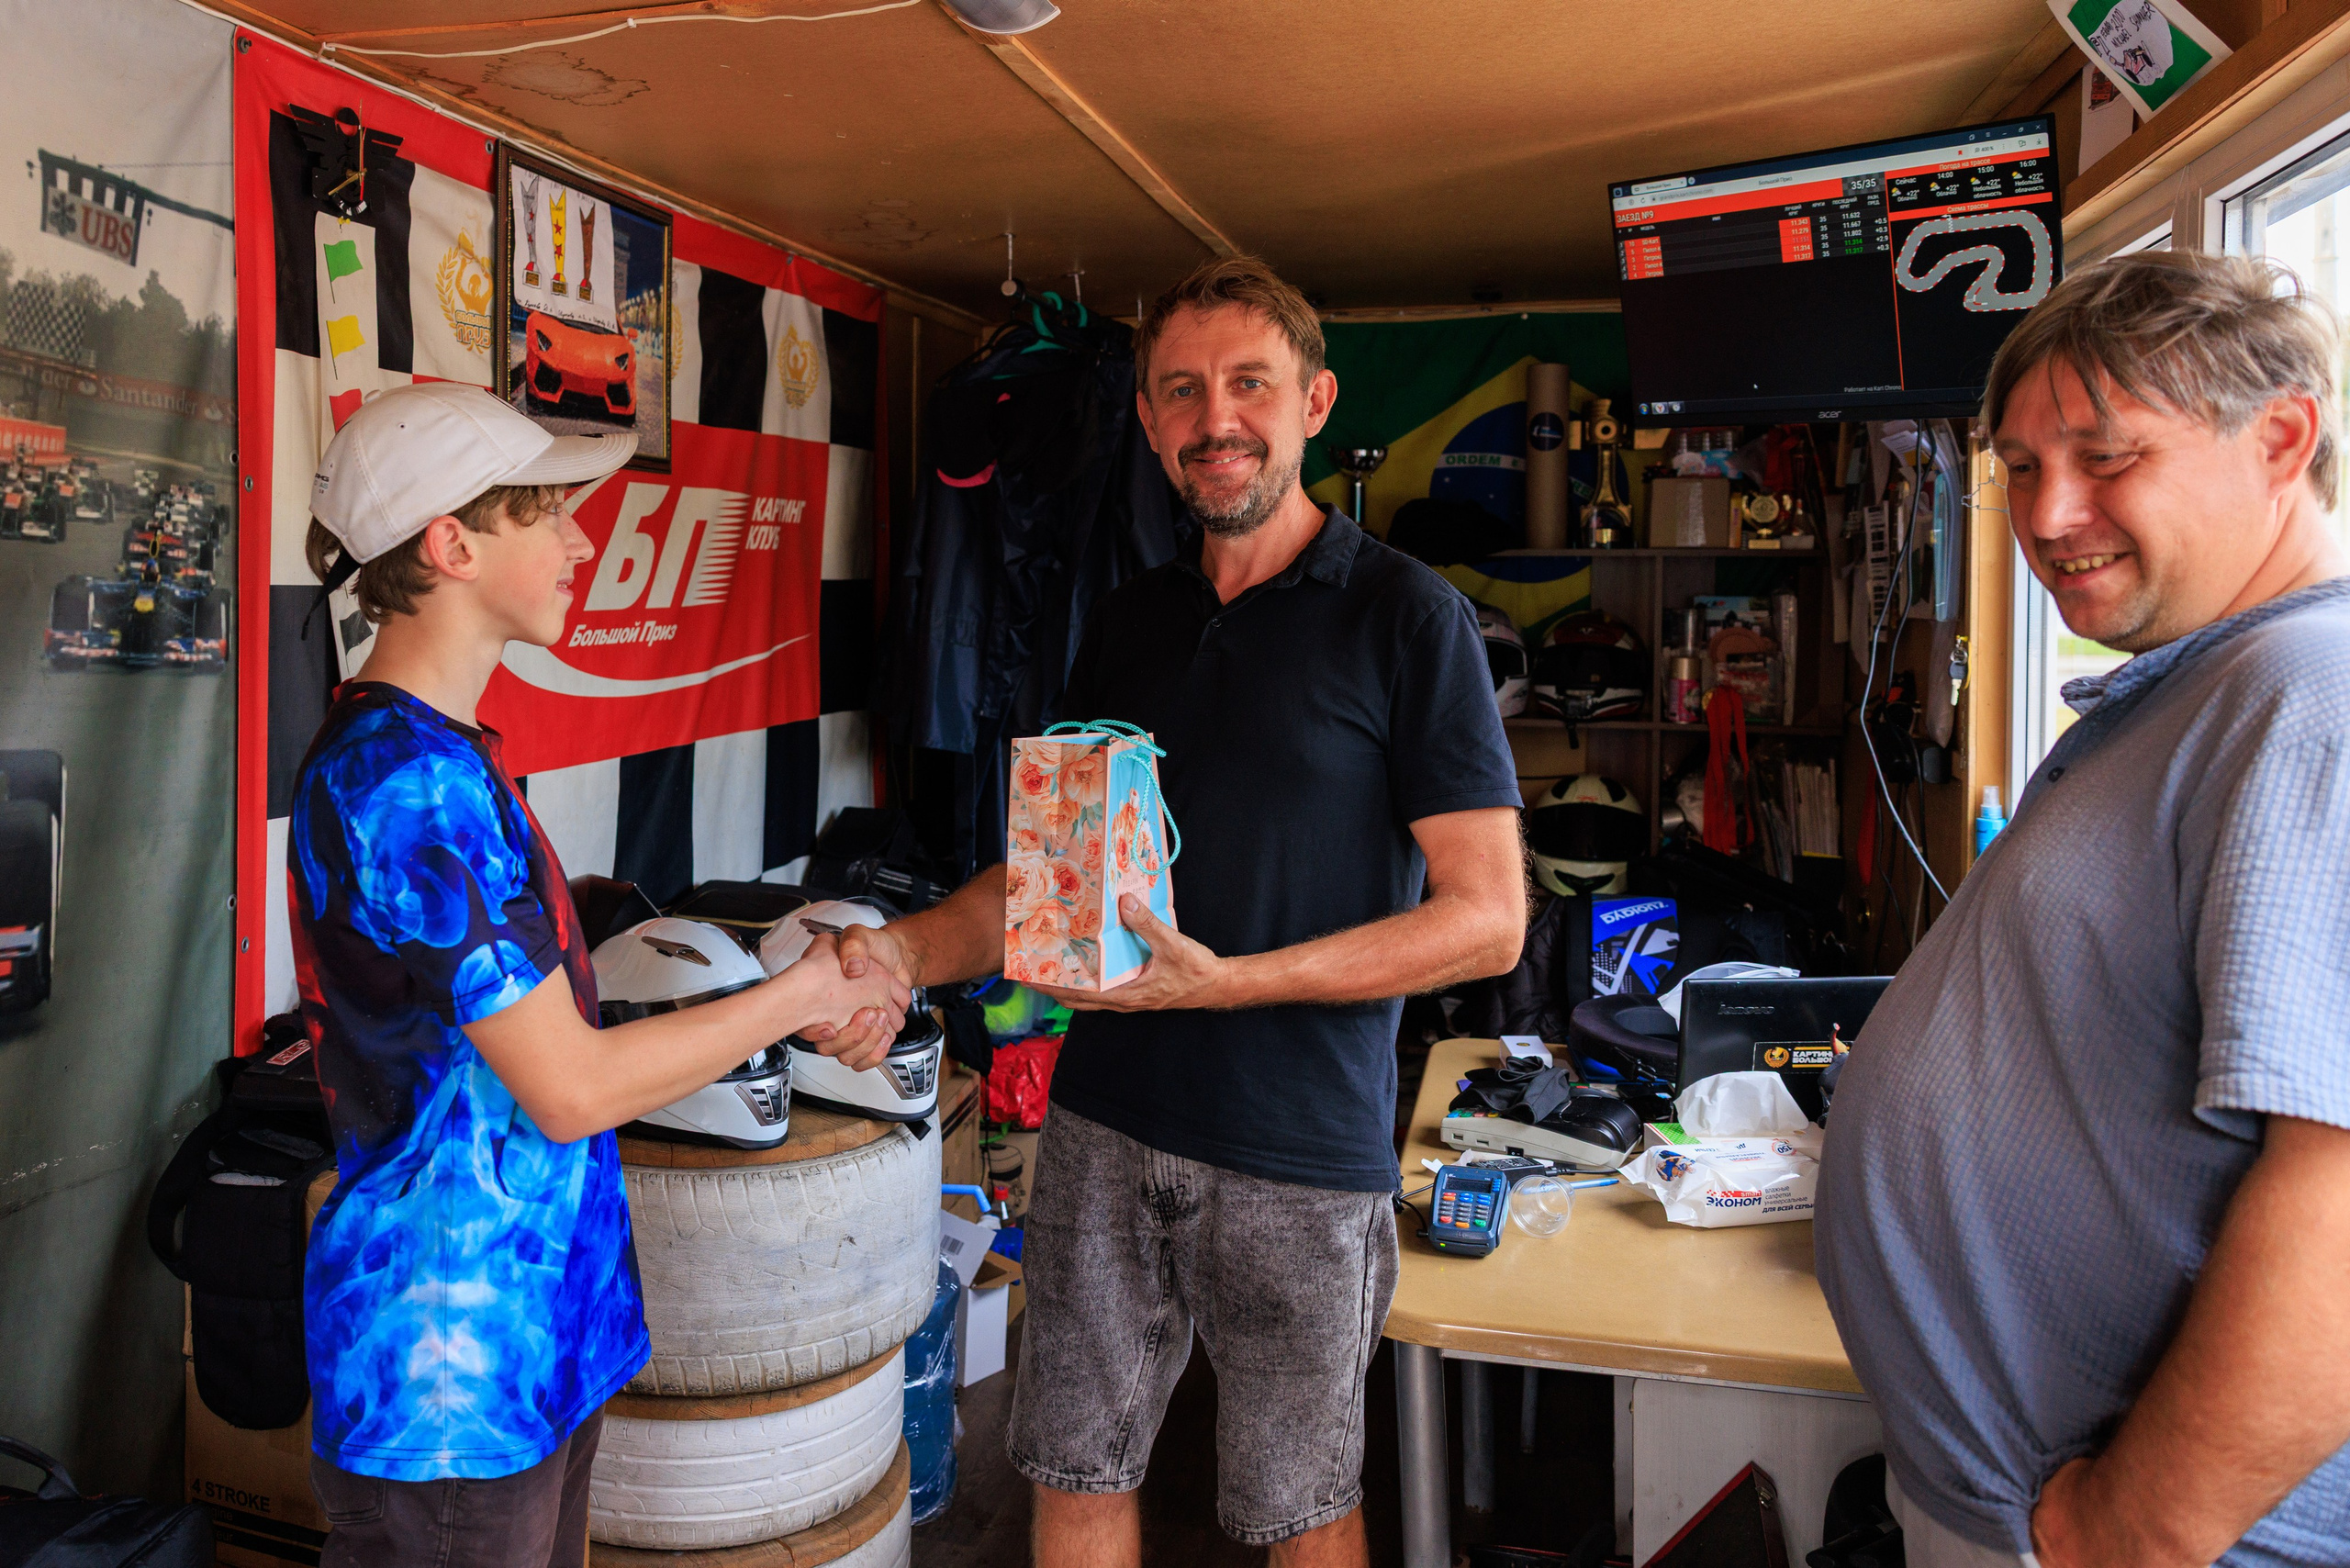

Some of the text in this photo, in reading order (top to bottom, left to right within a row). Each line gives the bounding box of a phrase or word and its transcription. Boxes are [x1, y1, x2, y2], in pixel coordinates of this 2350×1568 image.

[1939, 162, 1961, 172] Погода
[1970, 158, 1991, 167] трассе
[1977, 165, 1995, 174] 15:00
[2020, 160, 2037, 168] 16:00
[1851, 178, 1876, 190] 35/35
[1947, 203, 1989, 213] Схема трассы
[1617, 210, 1654, 223] ЗАЕЗД №9
[1842, 211, 1861, 219] 11.632
[1874, 217, 1887, 225] +0.5
[81, 205, 135, 260] UBS
[1877, 243, 1890, 252] +0.3
[101, 376, 198, 415] Santander
[1818, 410, 1842, 419] acer
[1446, 454, 1501, 466] ORDEM
[752, 497, 806, 524] КАРТИНГ
[745, 526, 781, 551] КЛУБ
[584, 482, 752, 611] БП
[568, 621, 677, 647] Большой Приз
[1718, 1003, 1775, 1015] lenovo
[1777, 1144, 1793, 1154] 150
[1707, 1196, 1762, 1207] ЭКОНОМ
[1763, 1196, 1808, 1206] универсальные
[1777, 1204, 1794, 1212] ВСЕЙ
[192, 1479, 271, 1513] 4 STROKE
